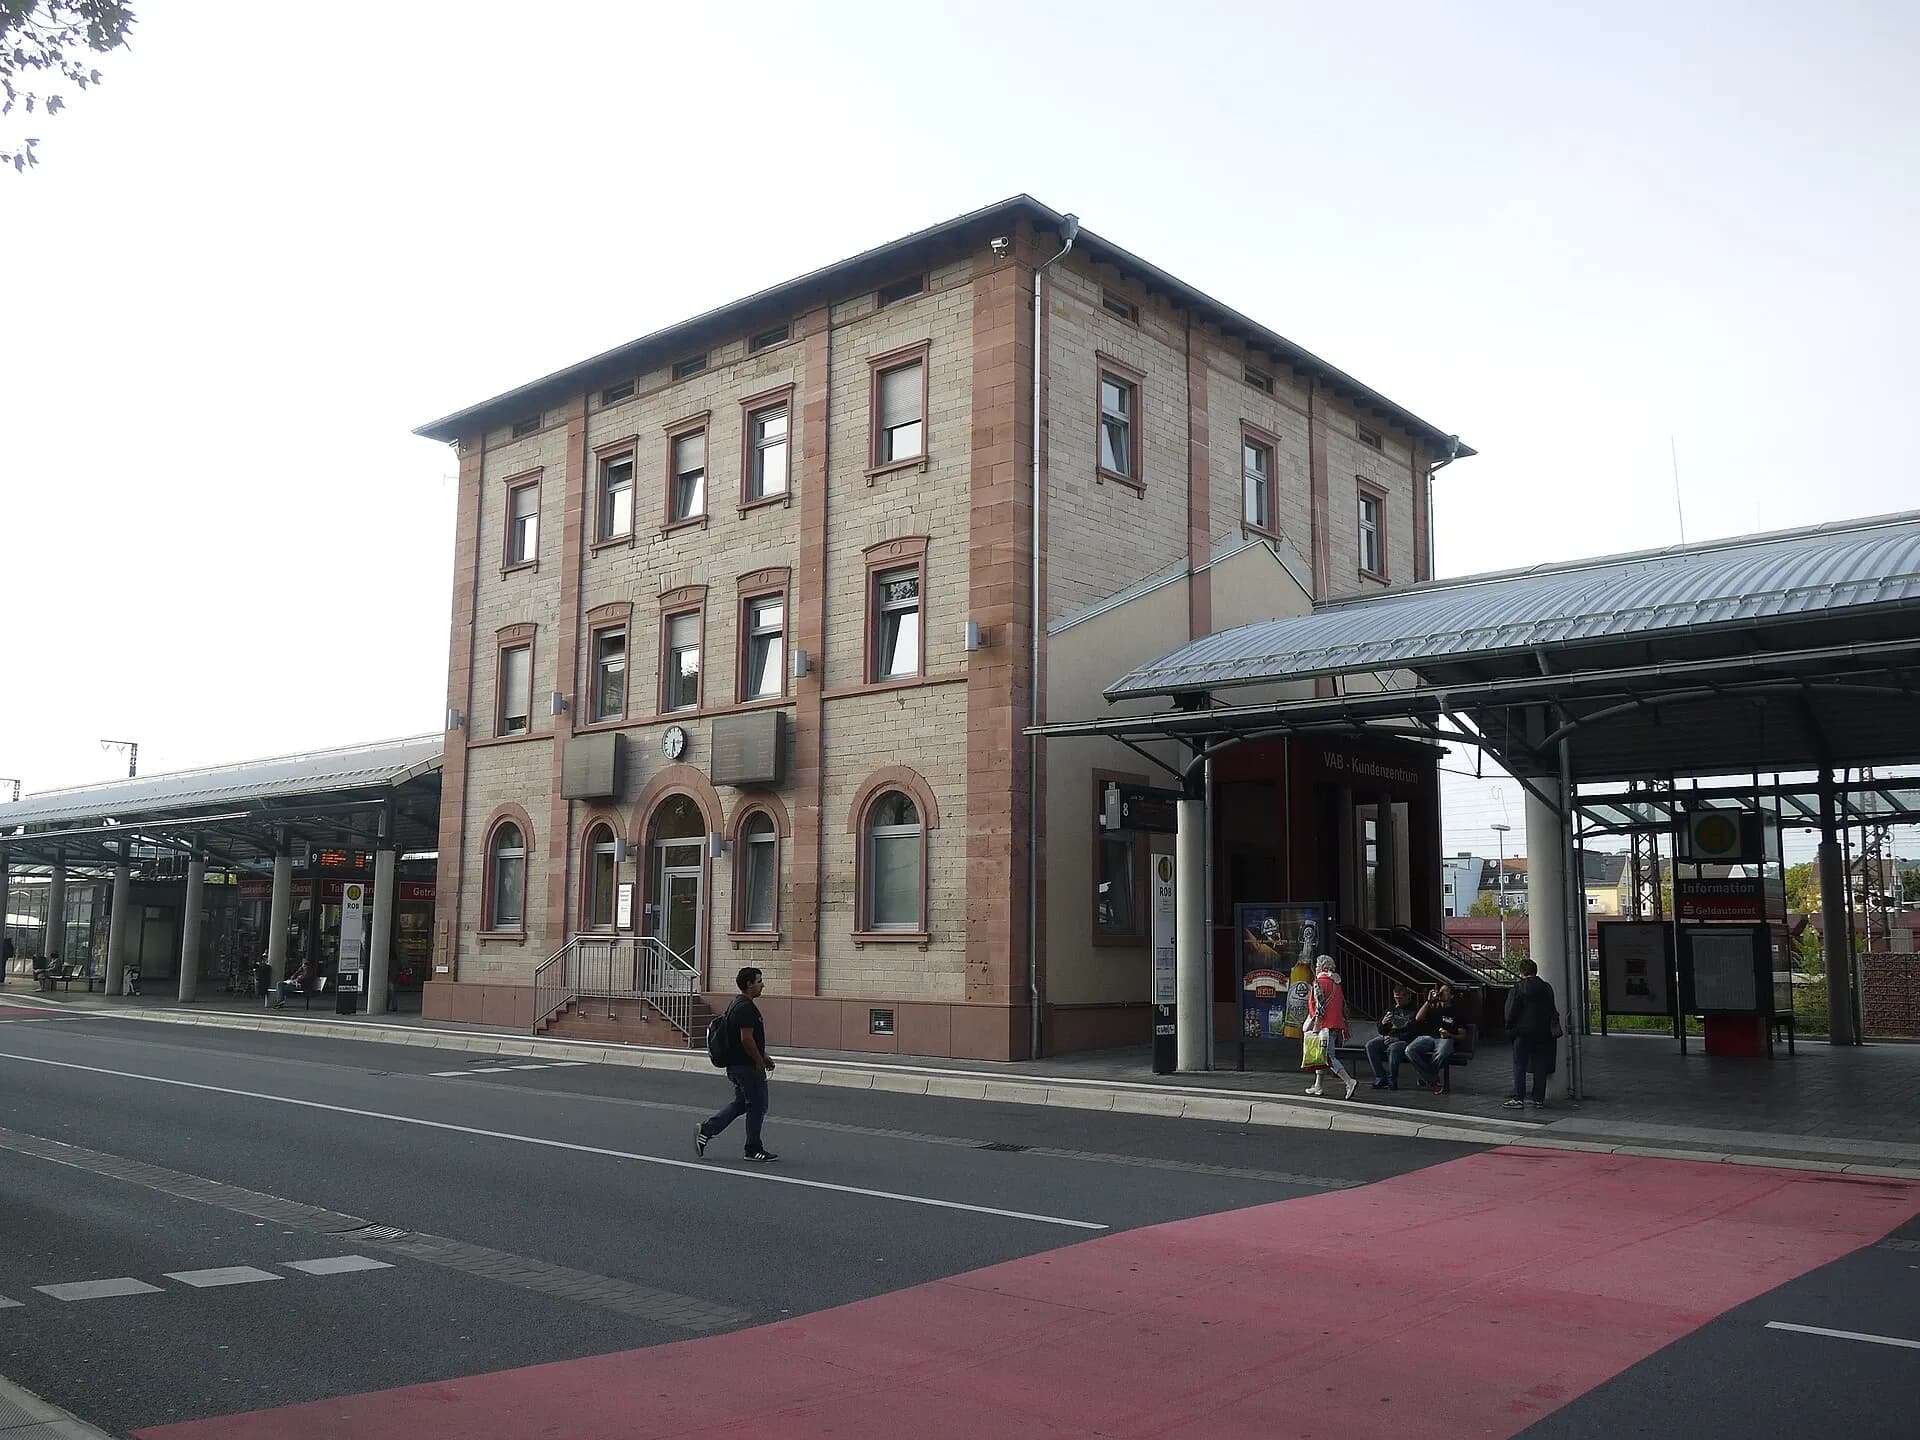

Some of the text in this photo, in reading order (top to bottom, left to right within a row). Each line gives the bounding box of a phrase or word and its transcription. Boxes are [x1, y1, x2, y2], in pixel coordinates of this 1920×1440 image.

[1323, 751, 1344, 769] VAB
[1351, 756, 1418, 784] Kundenzentrum
[1122, 801, 1129, 817] 8
[311, 853, 318, 863] 9
[1159, 886, 1171, 897] ROB
[1681, 882, 1755, 894] Information
[1695, 906, 1756, 915] Geldautomat
[1481, 943, 1497, 951] Cargo
